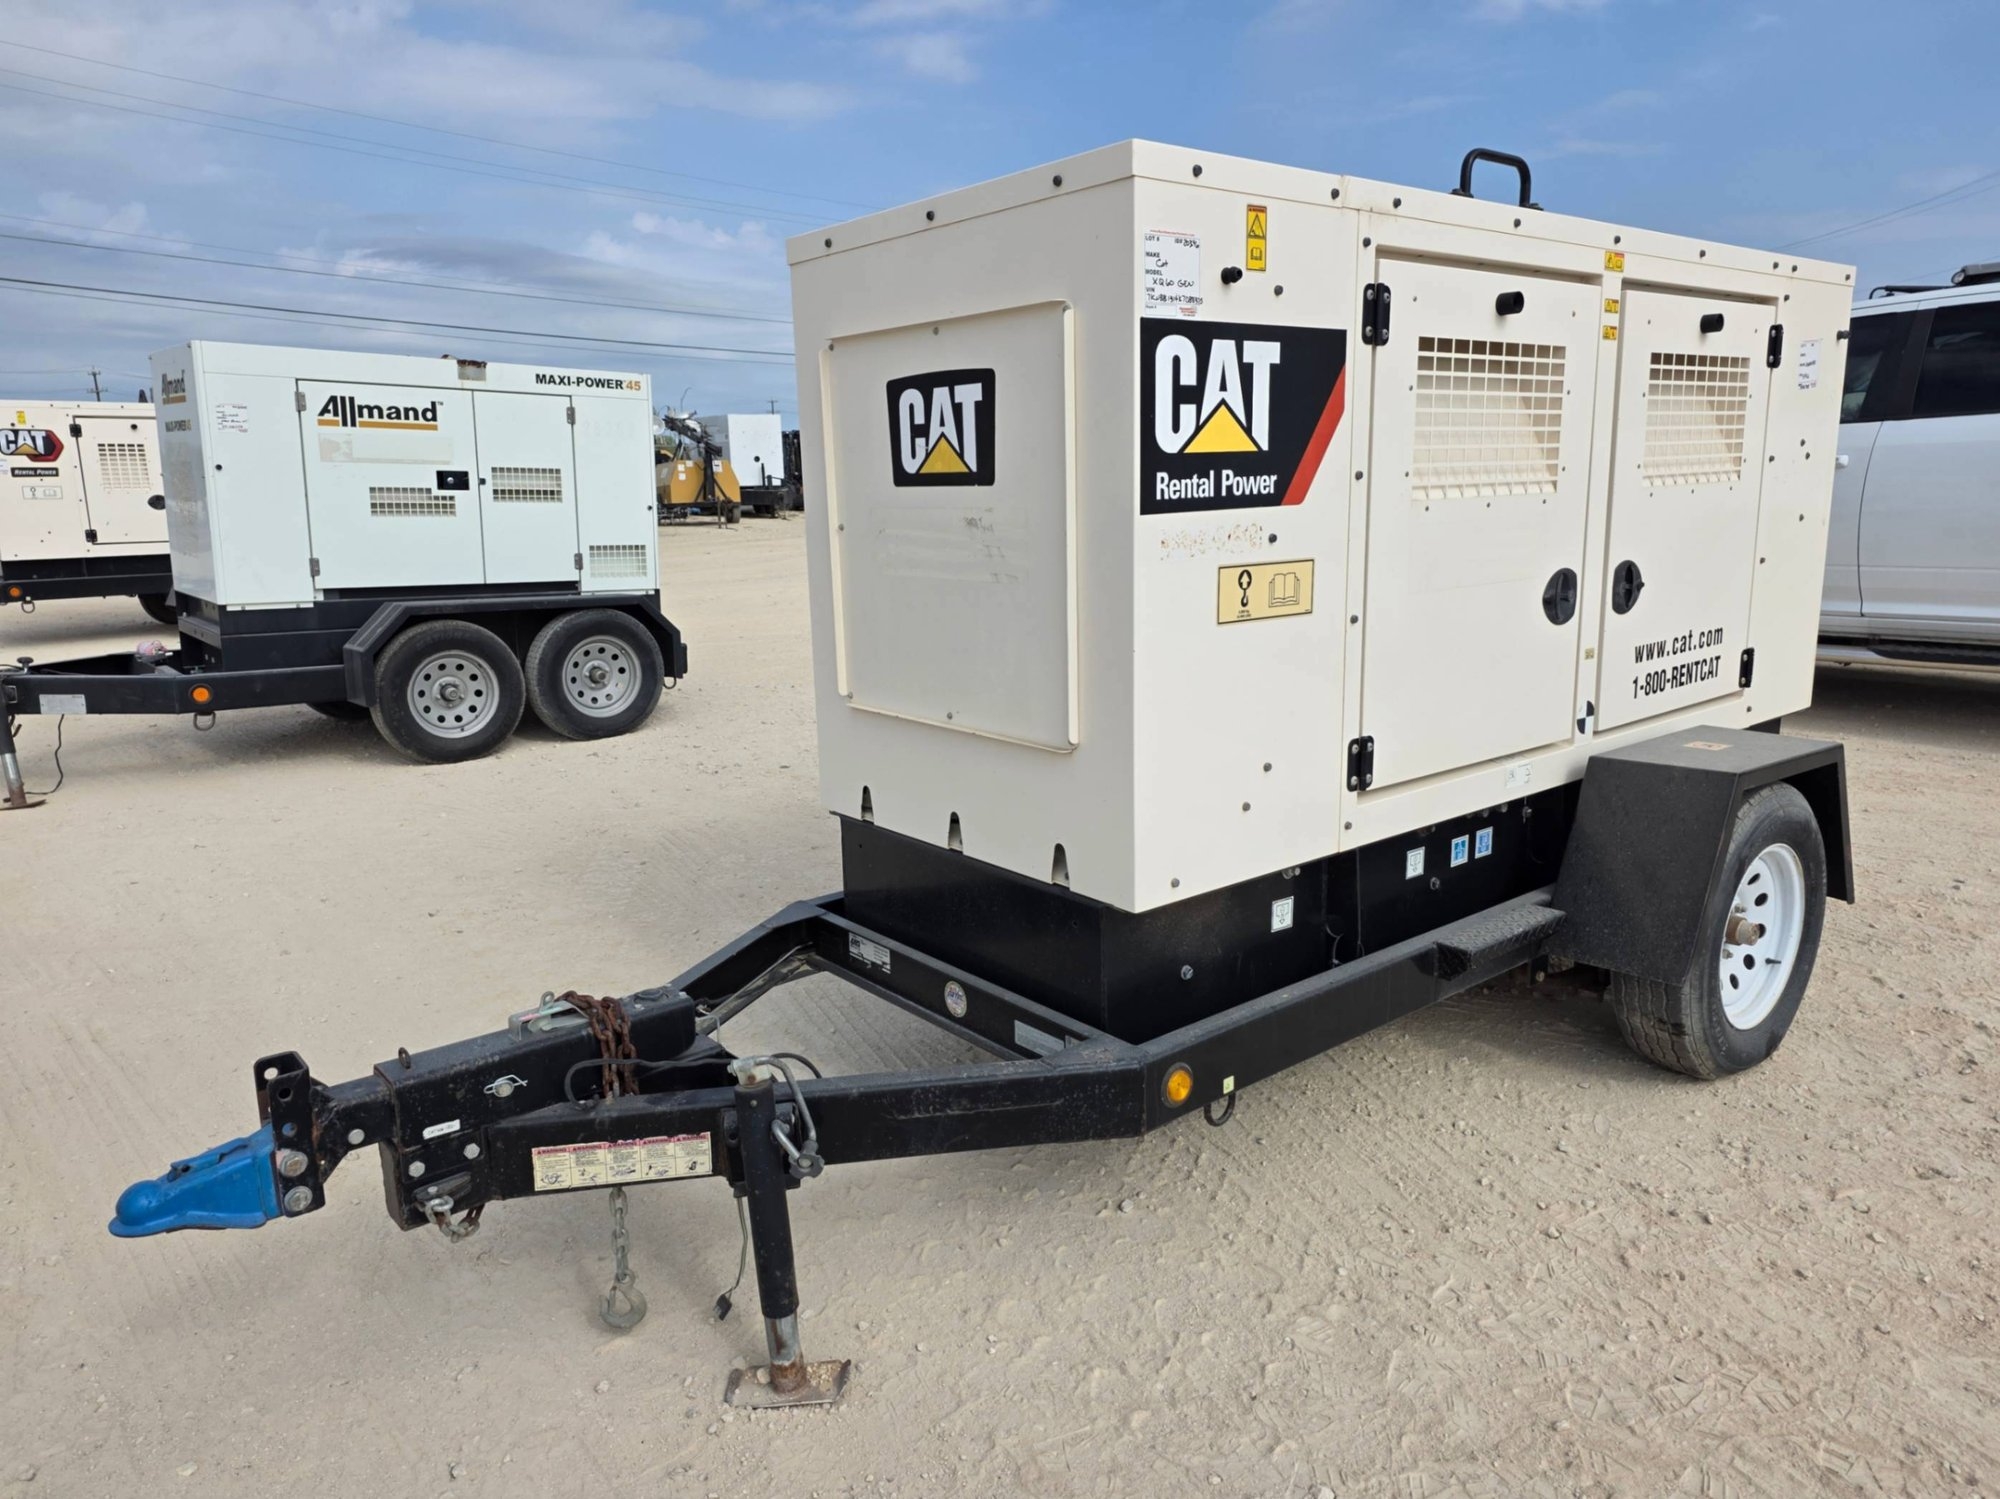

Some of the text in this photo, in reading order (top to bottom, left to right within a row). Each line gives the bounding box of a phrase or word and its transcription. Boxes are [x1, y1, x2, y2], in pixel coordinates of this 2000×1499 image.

[1145, 268, 1163, 276] MODEL
[626, 380, 642, 391] 45
[1155, 334, 1281, 454] CAT
[318, 395, 438, 427] Allmand
[0, 429, 46, 455] CAT
[899, 382, 983, 474] CAT
[1156, 469, 1277, 500] Rental Power
[1634, 627, 1723, 664] www.cat.com
[1632, 655, 1721, 699] 1-800-RENTCAT
